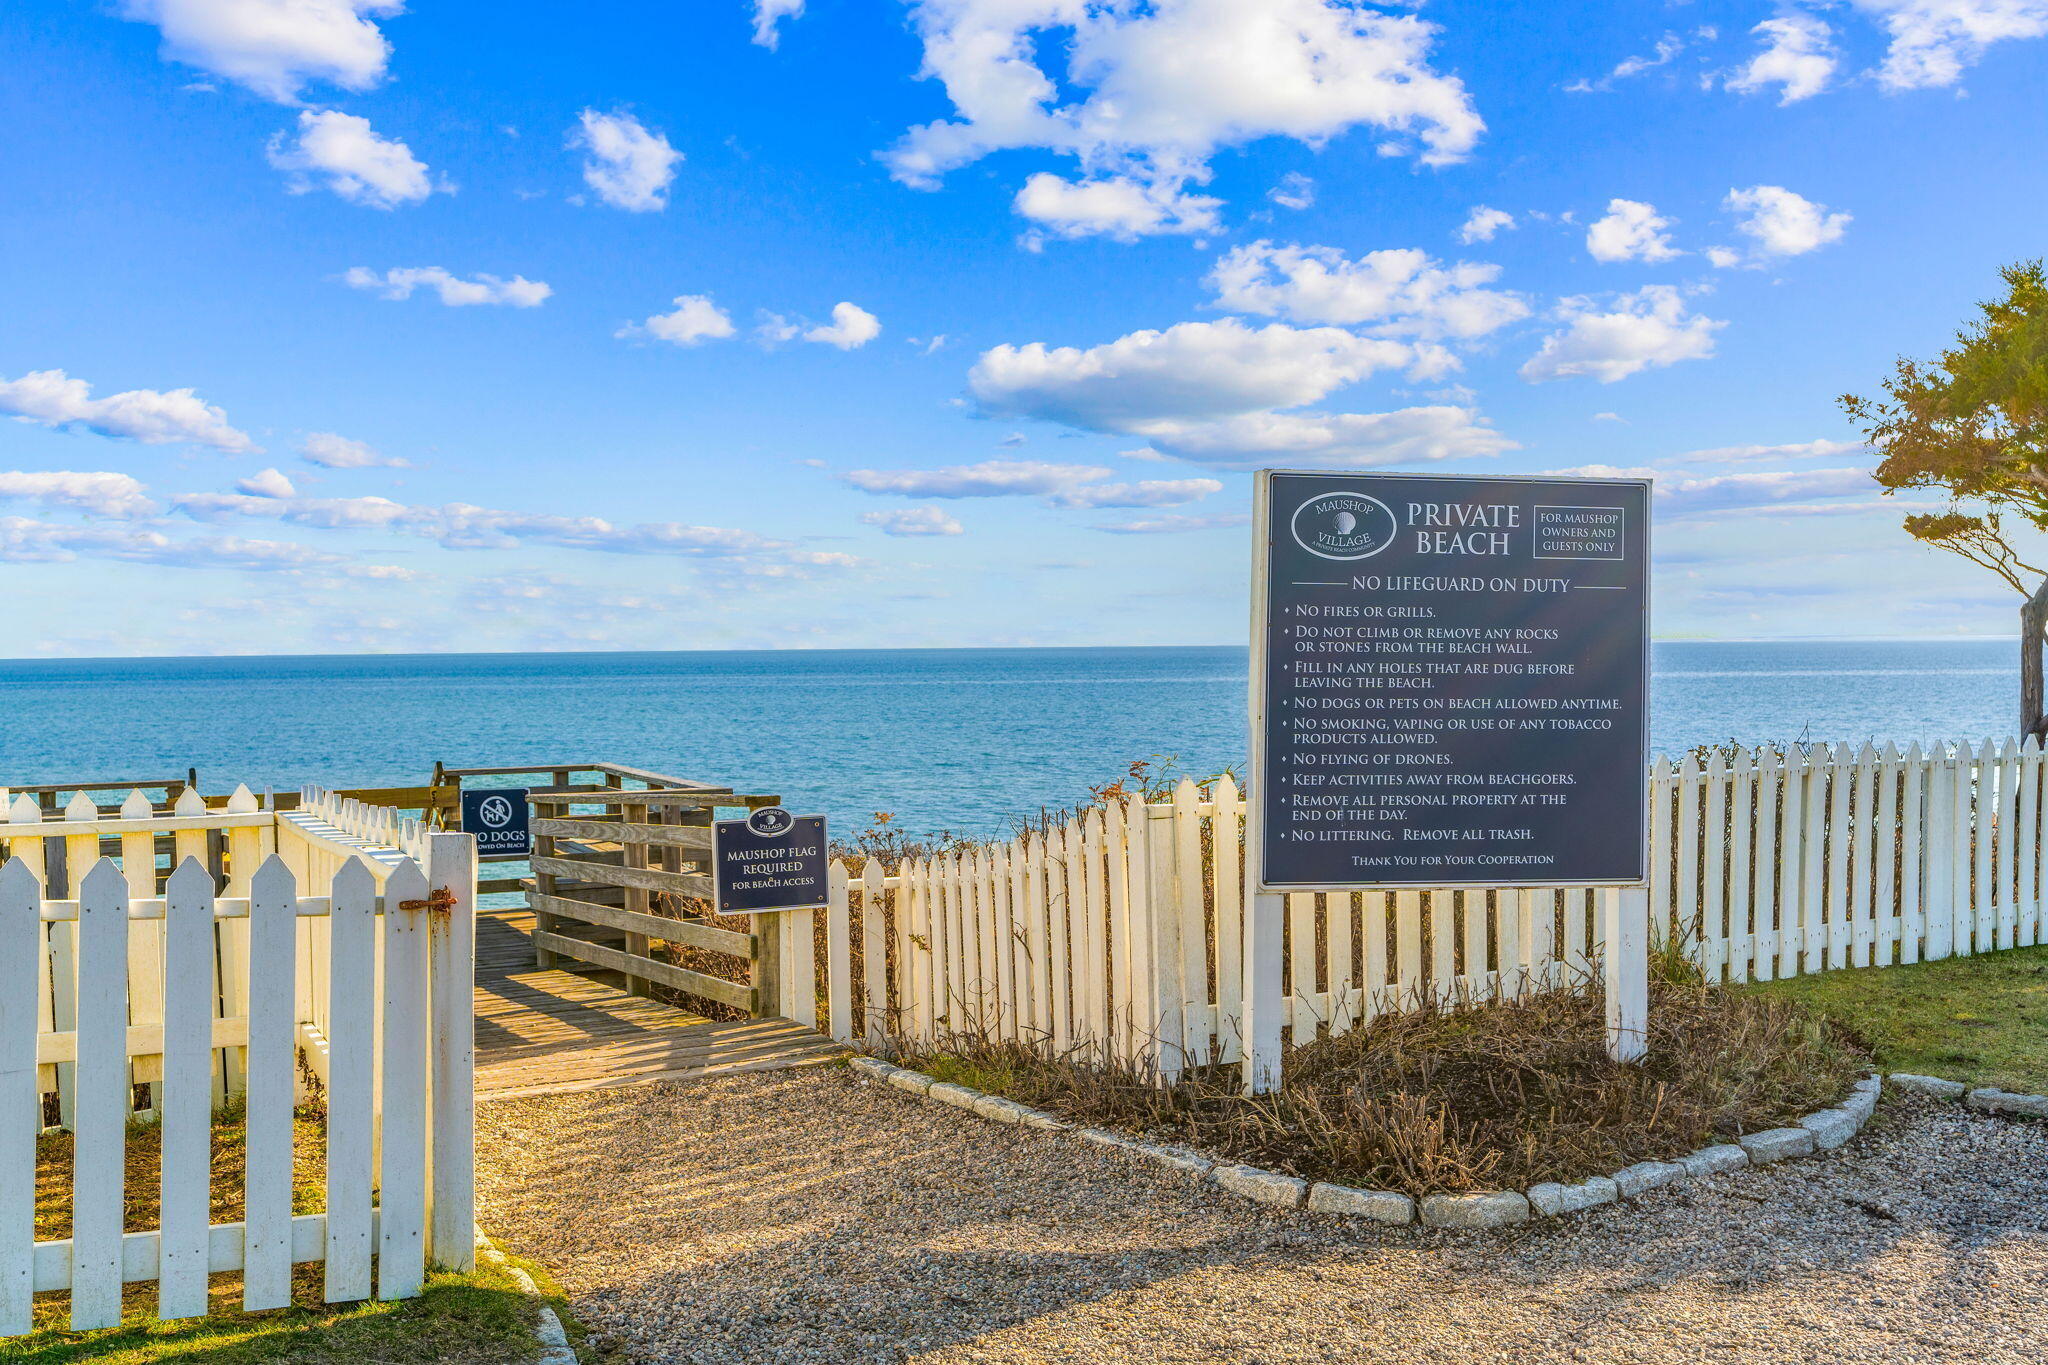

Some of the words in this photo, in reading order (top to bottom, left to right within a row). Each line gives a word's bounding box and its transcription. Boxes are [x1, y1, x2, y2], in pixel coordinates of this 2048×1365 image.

[1315, 500, 1374, 515] MAUSHOP
[1407, 503, 1519, 527] PRIVATE
[1541, 513, 1562, 522] FOR
[1565, 514, 1618, 524] MAUSHOP
[1543, 527, 1588, 537] OWNERS
[1591, 529, 1615, 538] AND
[1318, 532, 1371, 547] VILLAGE
[1416, 531, 1510, 555] BEACH
[1543, 541, 1583, 551] GUESTS
[1586, 542, 1615, 551] ONLY
[1353, 576, 1380, 590] NO
[1386, 577, 1484, 591] LIFEGUARD
[1490, 578, 1516, 591] ON
[1524, 579, 1569, 592] DUTY
[1324, 607, 1359, 616] FIRES
[1364, 607, 1384, 617] OR
[1387, 607, 1435, 617] GRILLS.
[1323, 627, 1353, 637] NOT
[1357, 628, 1398, 638] CLIMB
[1404, 628, 1423, 638] OR
[1427, 628, 1481, 638] REMOVE
[1485, 629, 1511, 639] ANY
[1516, 629, 1558, 639] ROCKS
[1295, 642, 1315, 652] OR
[1319, 642, 1370, 652] STONES
[1376, 642, 1413, 652] FROM
[1417, 643, 1444, 652] THE
[1449, 643, 1490, 653] BEACH
[1496, 643, 1532, 653] WALL.
[1328, 663, 1342, 673] IN
[1347, 663, 1375, 673] ANY
[1379, 663, 1421, 673] HOLES
[1426, 664, 1461, 673] THAT
[1464, 664, 1488, 673] ARE
[1494, 664, 1522, 674] DUG
[1528, 664, 1574, 674] BEFORE
[1295, 677, 1351, 687] LEAVING
[1356, 678, 1383, 688] THE
[1389, 678, 1434, 688] BEACH.
[1322, 698, 1360, 708] DOGS
[1365, 699, 1385, 708] OR
[1389, 699, 1418, 708] PETS
[1423, 699, 1443, 709] ON
[1449, 699, 1491, 709] BEACH
[1496, 699, 1557, 709] ALLOWED
[1561, 699, 1621, 709] ANYTIME.
[1321, 719, 1389, 730] SMOKING,
[1394, 719, 1443, 729] VAPING
[1448, 719, 1467, 729] OR
[1472, 719, 1494, 729] USE
[1499, 719, 1515, 729] OF
[1519, 720, 1546, 729] ANY
[1550, 719, 1611, 729] TOBACCO
[1294, 734, 1366, 744] PRODUCTS
[1370, 734, 1437, 744] ALLOWED.
[1321, 754, 1368, 764] FLYING
[1373, 754, 1390, 764] OF
[1396, 754, 1453, 764] DRONES.
[1329, 775, 1402, 785] ACTIVITIES
[1407, 775, 1442, 784] AWAY
[1447, 775, 1484, 784] FROM
[1489, 774, 1576, 784] BEACHGOERS.
[1352, 796, 1376, 806] ALL
[1381, 795, 1448, 805] PERSONAL
[1453, 795, 1518, 805] PROPERTY
[1521, 795, 1536, 804] AT
[1540, 795, 1566, 804] THE
[1293, 810, 1321, 820] END
[1326, 810, 1343, 820] OF
[1347, 810, 1374, 820] THE
[1380, 810, 1407, 820] DAY.
[475, 832, 488, 842] O
[491, 831, 525, 841] DOGS
[1320, 830, 1394, 841] LITTERING.
[1462, 830, 1485, 839] ALL
[1489, 830, 1534, 839] TRASH.
[727, 848, 786, 861] MAUSHOP
[788, 846, 816, 857] FLAG
[743, 862, 803, 876] REQUIRED
[732, 881, 751, 890] FOR
[752, 880, 781, 889] BEACH
[783, 877, 815, 886] ACCESS
